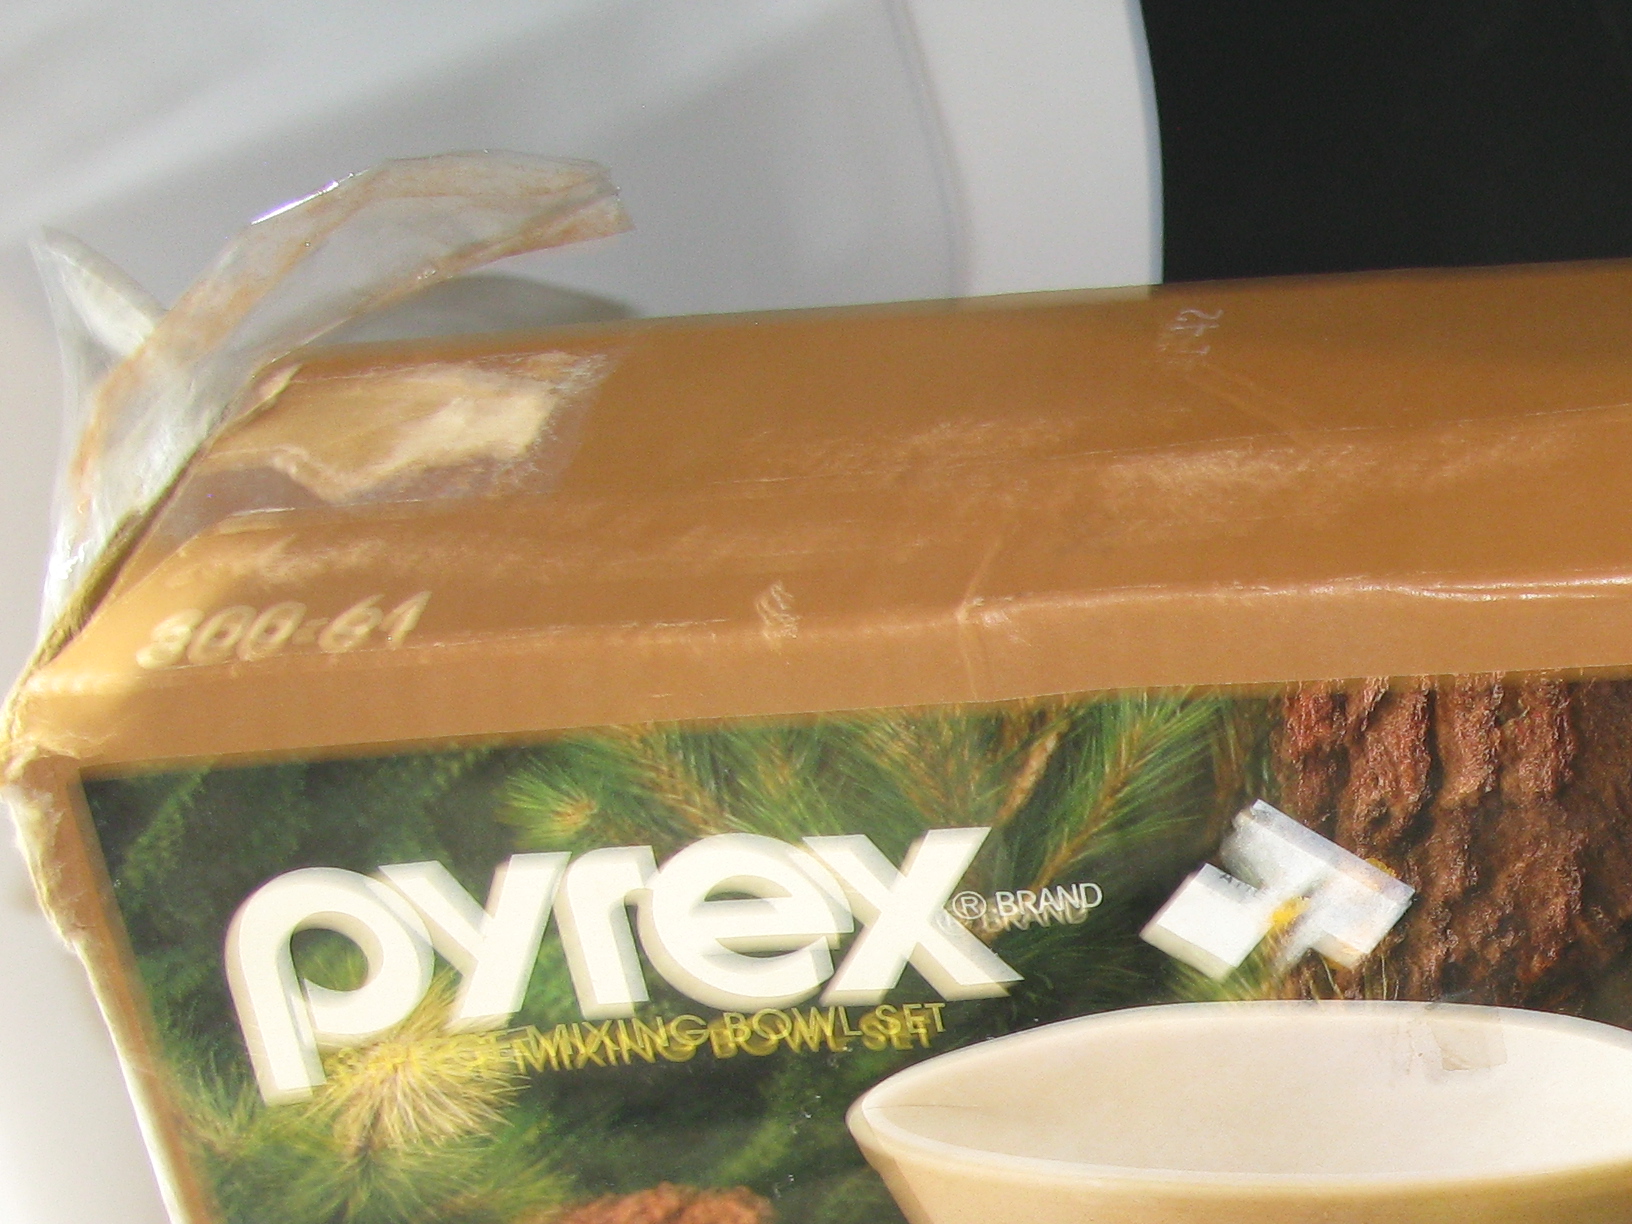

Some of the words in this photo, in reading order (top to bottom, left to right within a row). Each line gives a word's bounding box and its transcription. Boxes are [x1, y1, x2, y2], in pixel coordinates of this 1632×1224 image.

[994, 882, 1103, 920] BRAND
[226, 827, 1024, 1106] pyrex
[520, 1013, 711, 1068] MIXING
[718, 1004, 862, 1050] BOWL
[868, 1001, 946, 1043] SET
